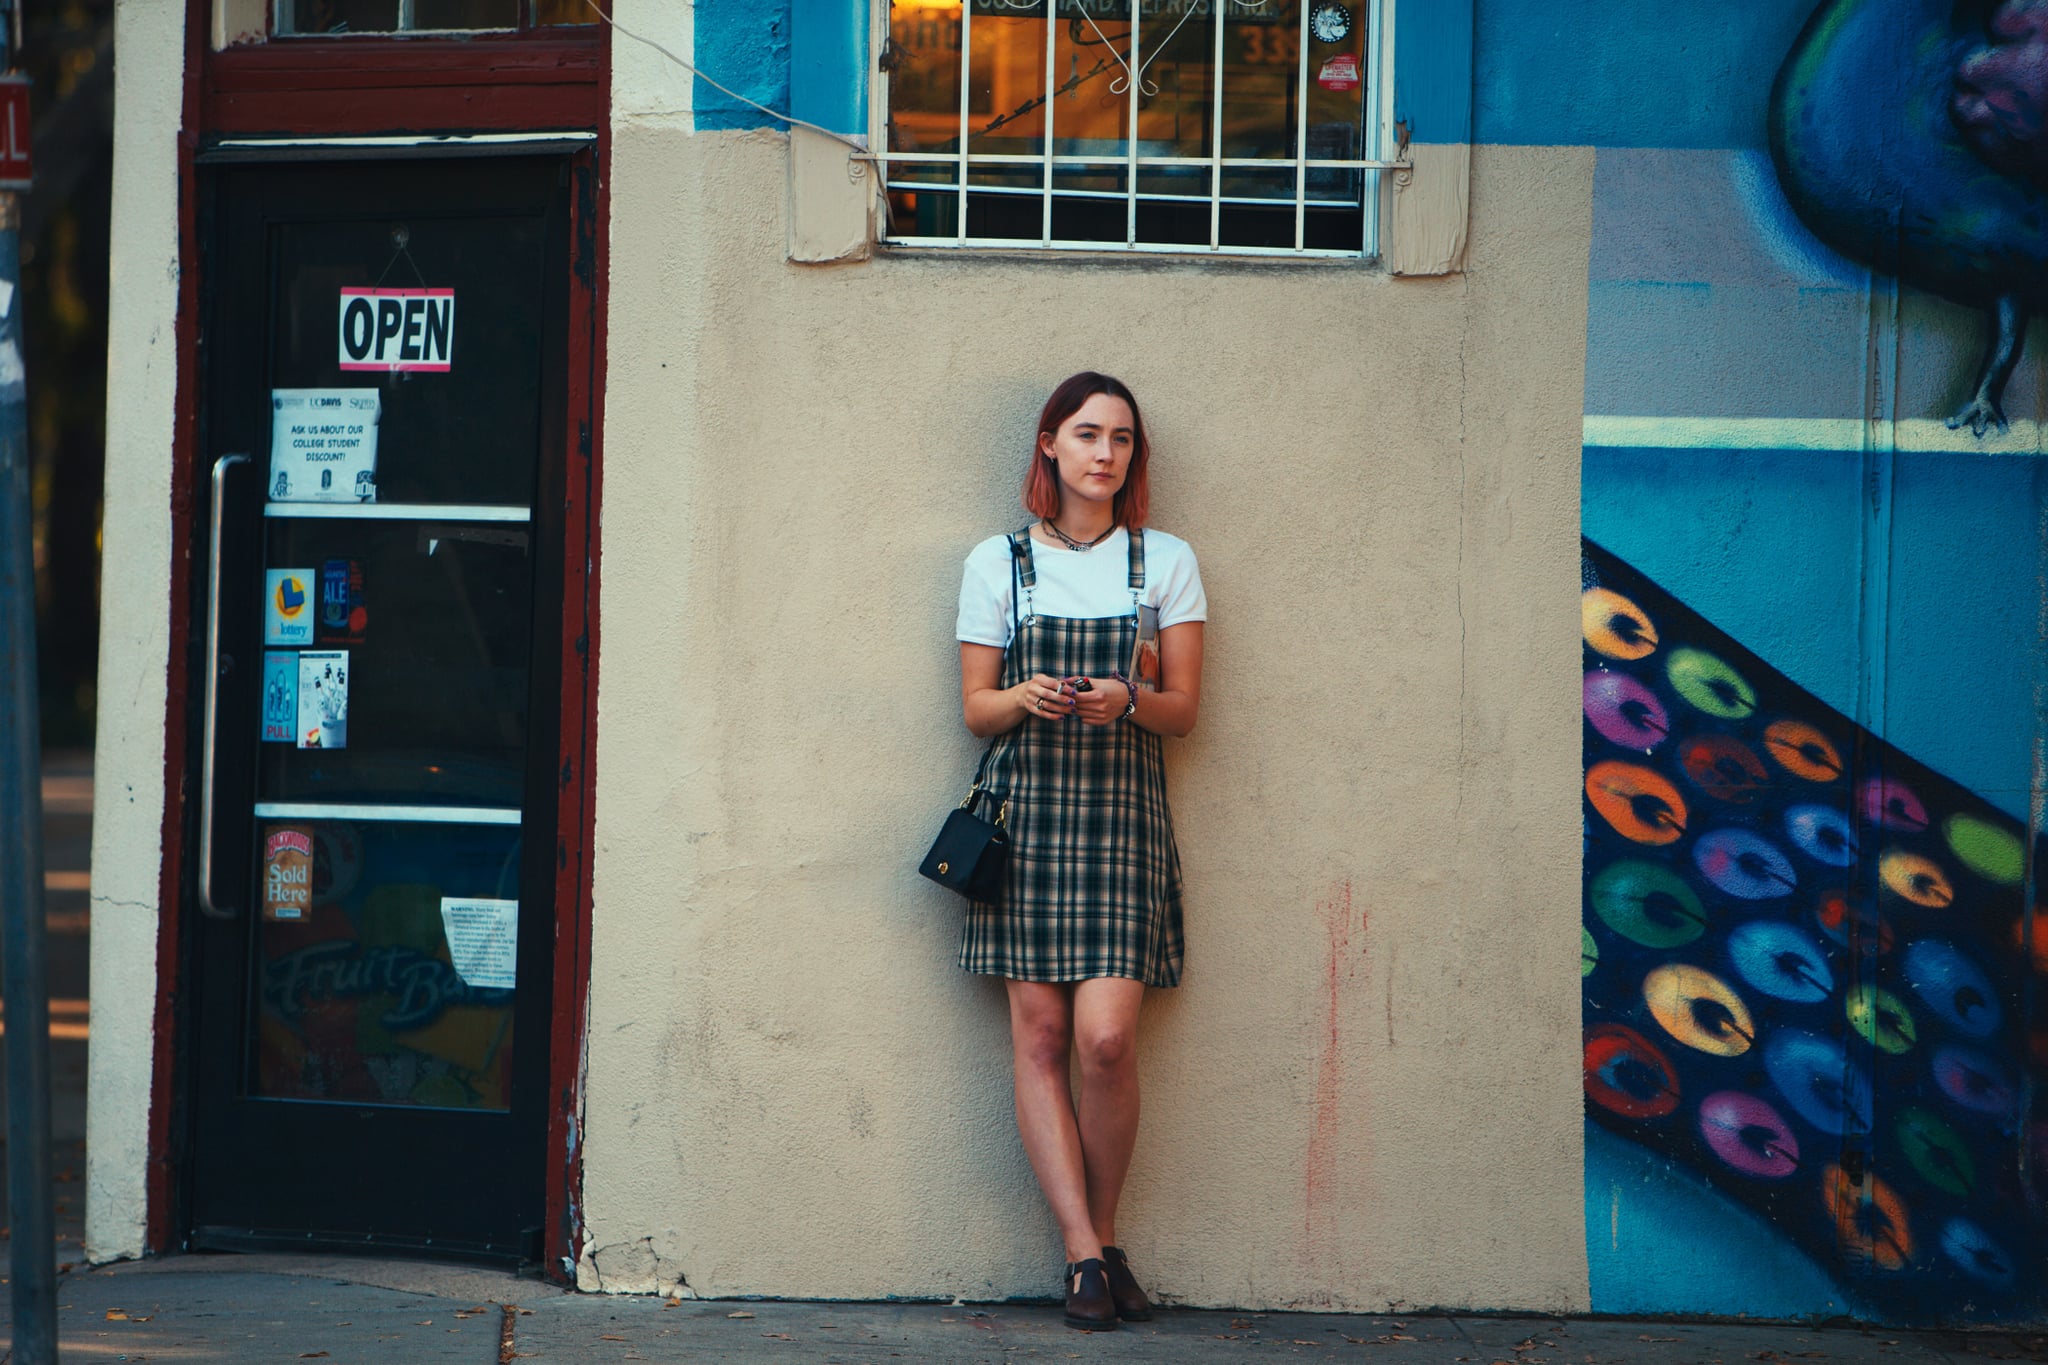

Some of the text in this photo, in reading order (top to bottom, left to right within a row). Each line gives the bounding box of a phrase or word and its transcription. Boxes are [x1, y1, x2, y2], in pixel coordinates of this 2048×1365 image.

[0, 101, 28, 160] L
[343, 297, 450, 361] OPEN
[291, 425, 364, 434] ASK US ABOUT OUR
[293, 439, 361, 448] COLLEGE STUDENT
[306, 452, 346, 462] DISCOUNT!
[324, 582, 346, 604] ALE
[266, 725, 291, 738] PULL
[267, 830, 310, 860] BACKWOODS
[269, 863, 307, 884] Sold
[267, 883, 307, 903] Here
[270, 939, 417, 1014] Fruit
